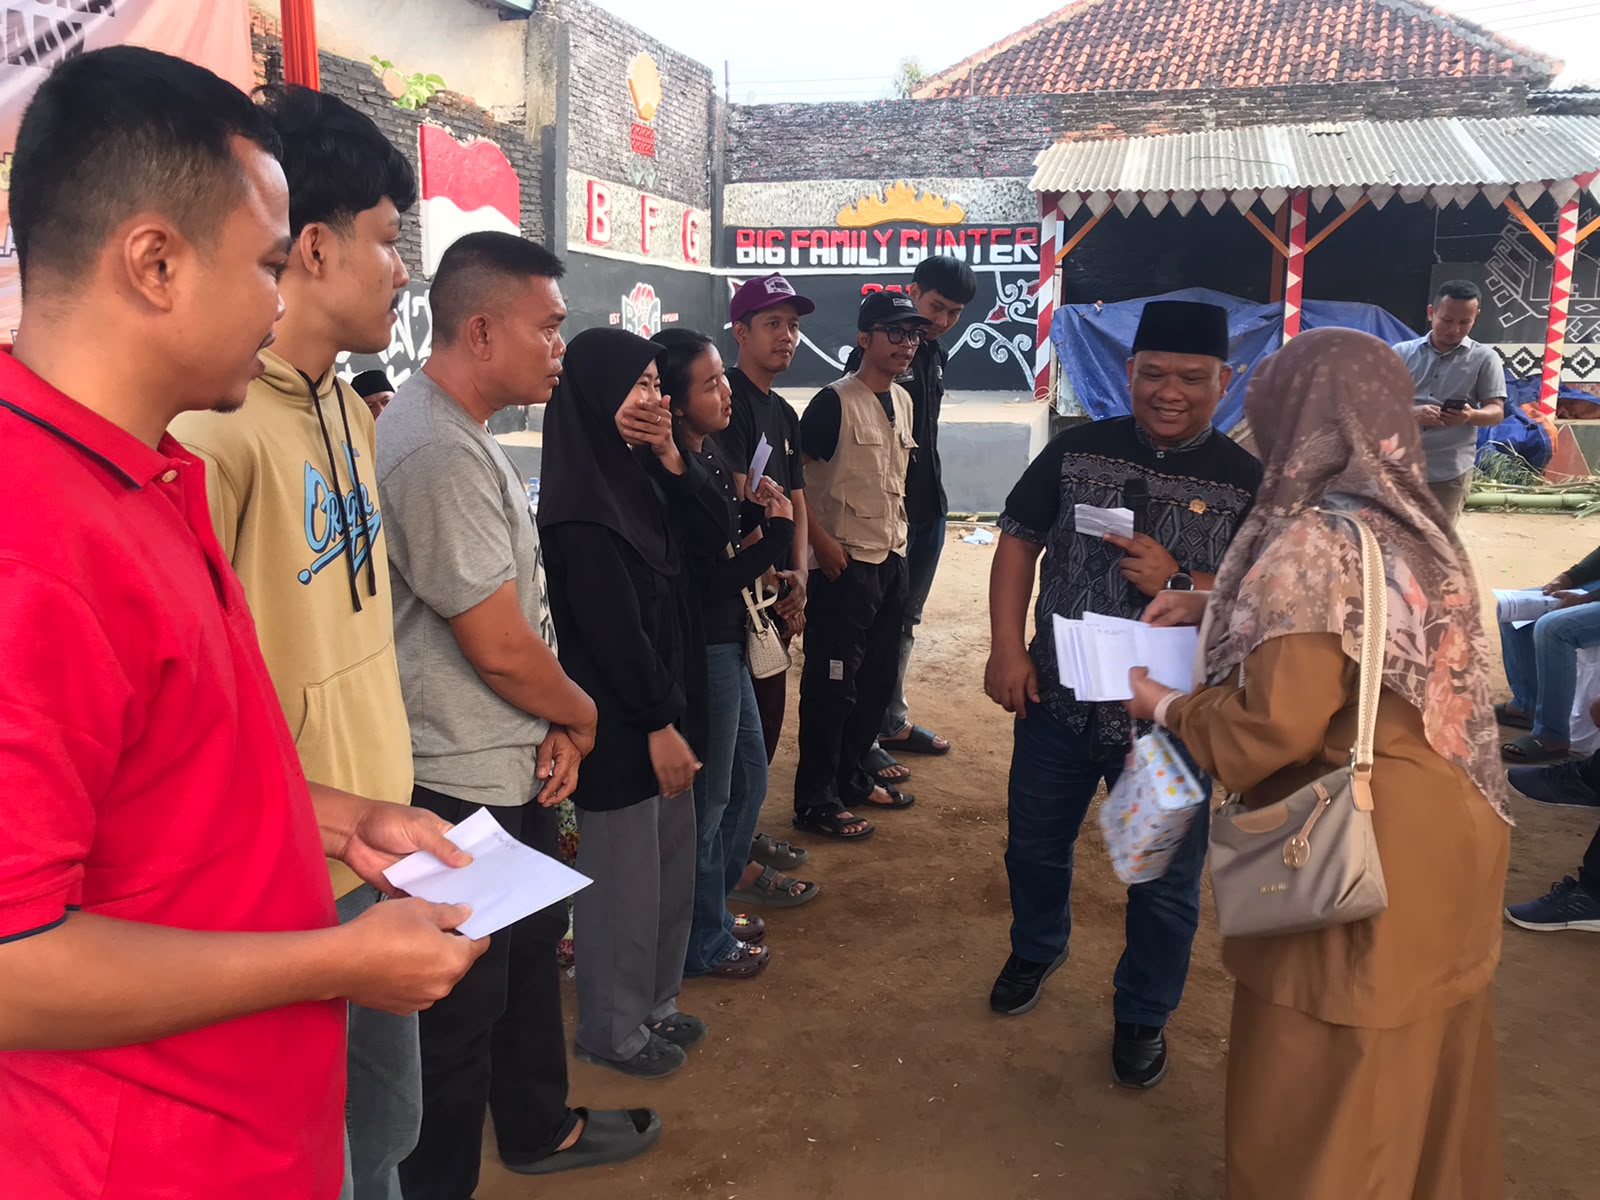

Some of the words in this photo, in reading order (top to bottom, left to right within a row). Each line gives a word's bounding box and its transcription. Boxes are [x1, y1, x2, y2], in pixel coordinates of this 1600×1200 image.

[736, 228, 786, 265] BIG
[790, 228, 894, 266] FAMILY
[899, 227, 1039, 266] GUNTER
